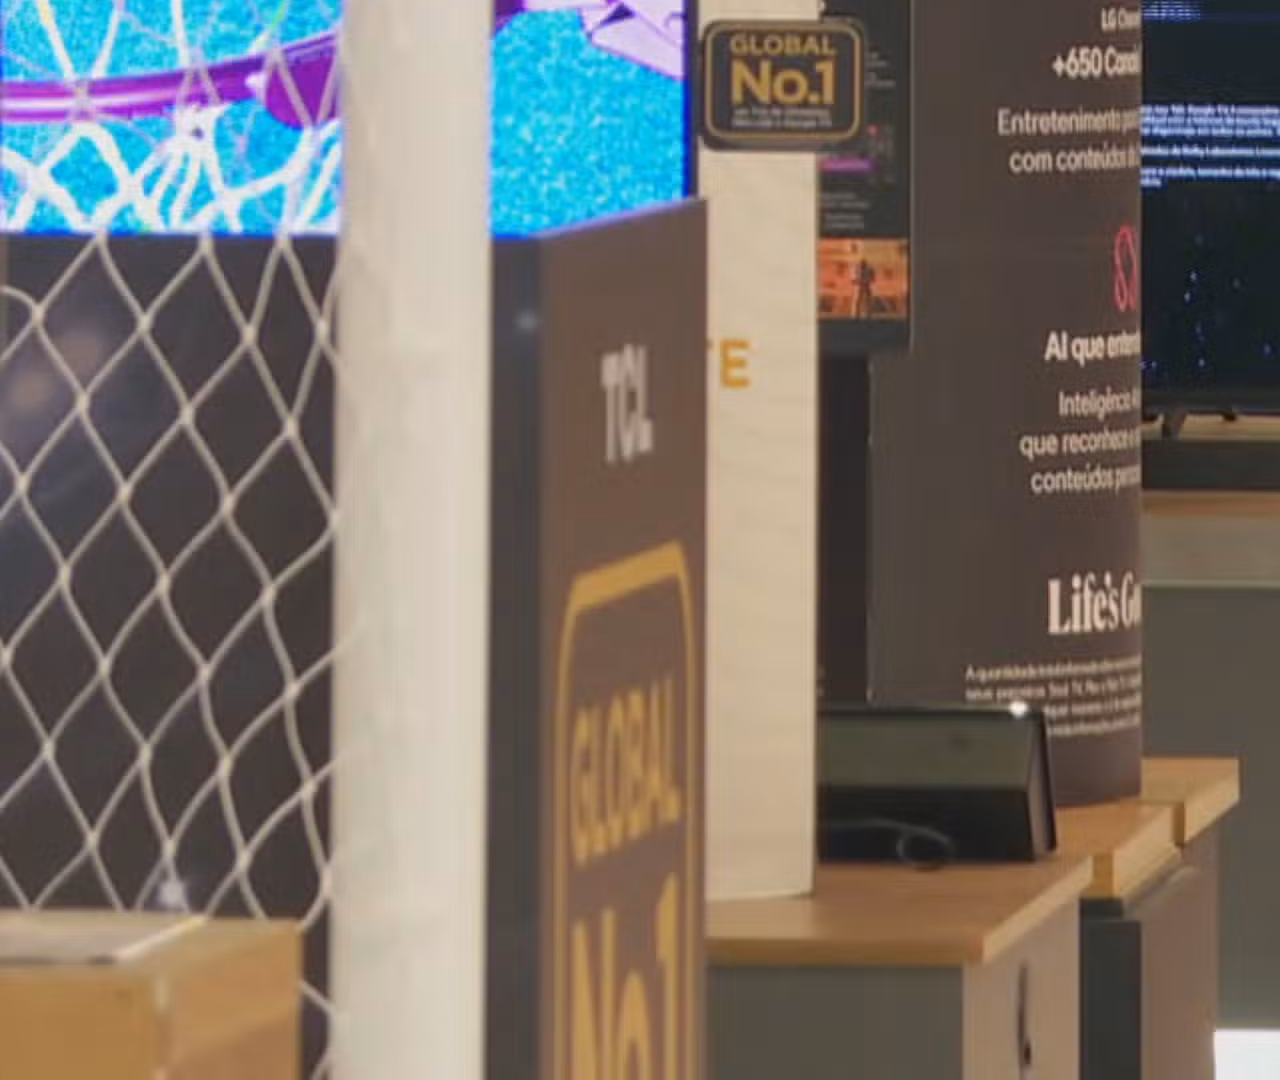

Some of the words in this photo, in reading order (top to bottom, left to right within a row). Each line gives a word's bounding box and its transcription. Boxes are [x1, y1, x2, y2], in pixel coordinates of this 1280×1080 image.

[731, 34, 836, 55] GLOBAL
[1053, 47, 1103, 77] +650
[732, 59, 835, 105] No.1
[1009, 151, 1052, 173] com
[1045, 331, 1068, 360] AI
[1071, 335, 1105, 366] que
[602, 345, 652, 462] TCL
[1020, 432, 1058, 460] que
[1048, 571, 1119, 634] Life's
[571, 675, 681, 866] GLOBAL
